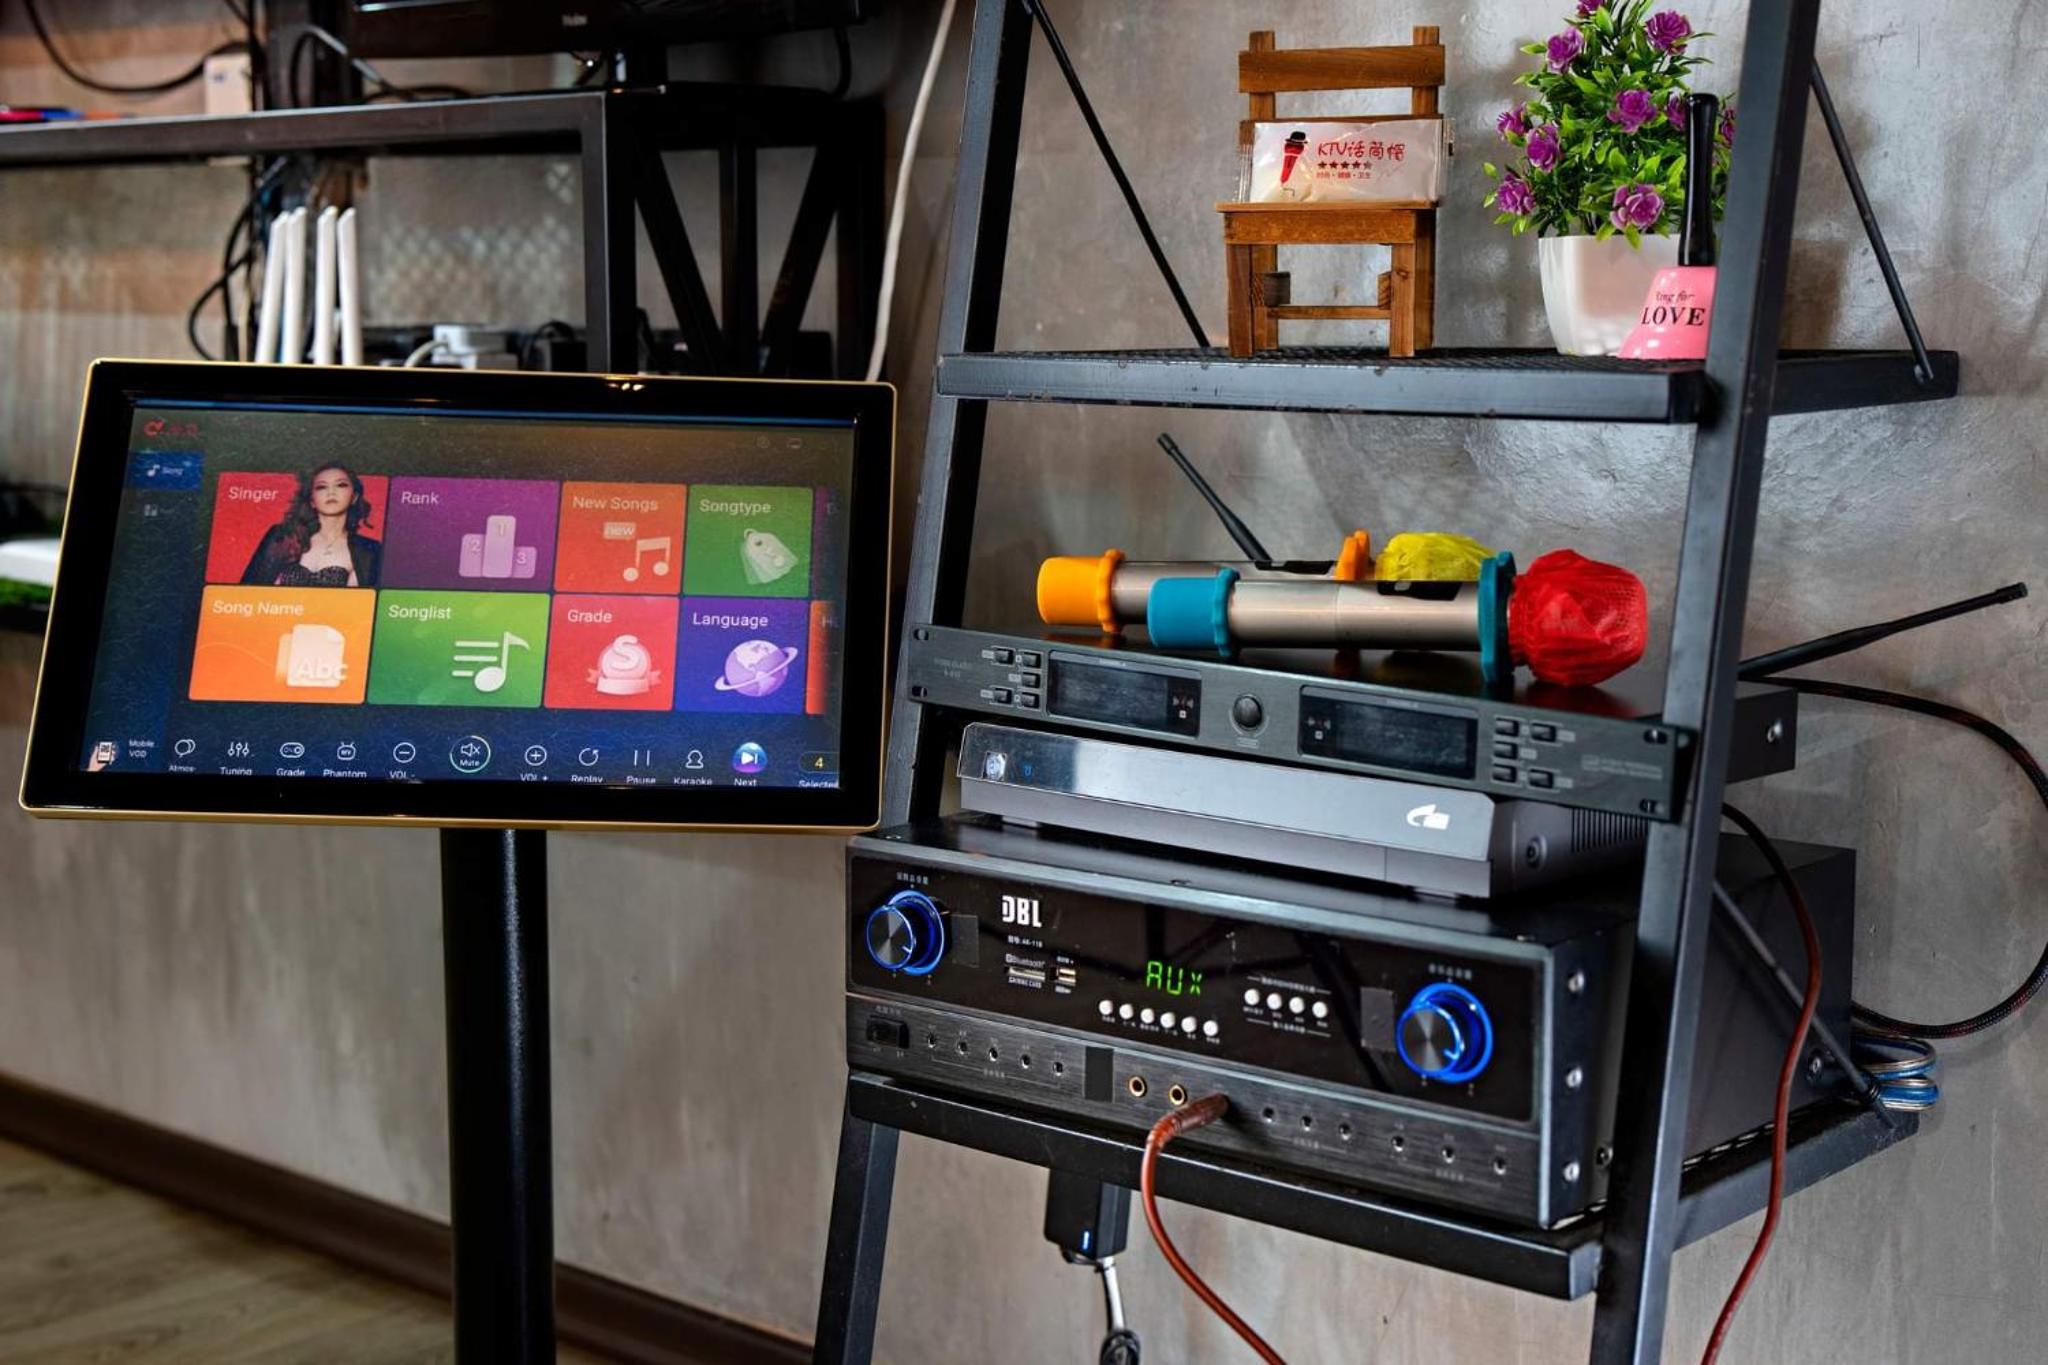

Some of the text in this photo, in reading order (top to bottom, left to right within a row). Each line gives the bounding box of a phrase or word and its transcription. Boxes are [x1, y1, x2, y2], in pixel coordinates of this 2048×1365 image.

[1641, 306, 1706, 326] LOVE
[228, 486, 278, 502] Singer
[401, 491, 439, 505] Rank
[573, 496, 658, 512] New Songs
[699, 498, 771, 515] Songtype
[605, 525, 635, 536] new
[516, 551, 526, 564] 3
[212, 600, 304, 616] Song Name
[388, 604, 452, 621] Songlist
[567, 609, 612, 623] Grade
[692, 613, 768, 629] Language
[295, 660, 348, 681] Abc
[129, 739, 155, 748] Mobile
[129, 750, 147, 758] VOD
[459, 759, 480, 767] Mute
[814, 757, 824, 769] 4
[219, 766, 252, 776] Tuning
[276, 768, 305, 777] Grade
[323, 768, 367, 778] Phantom
[626, 775, 656, 785] Pause
[673, 777, 713, 786] Karaoke
[733, 778, 757, 787] Next
[1002, 895, 1042, 928] DBL
